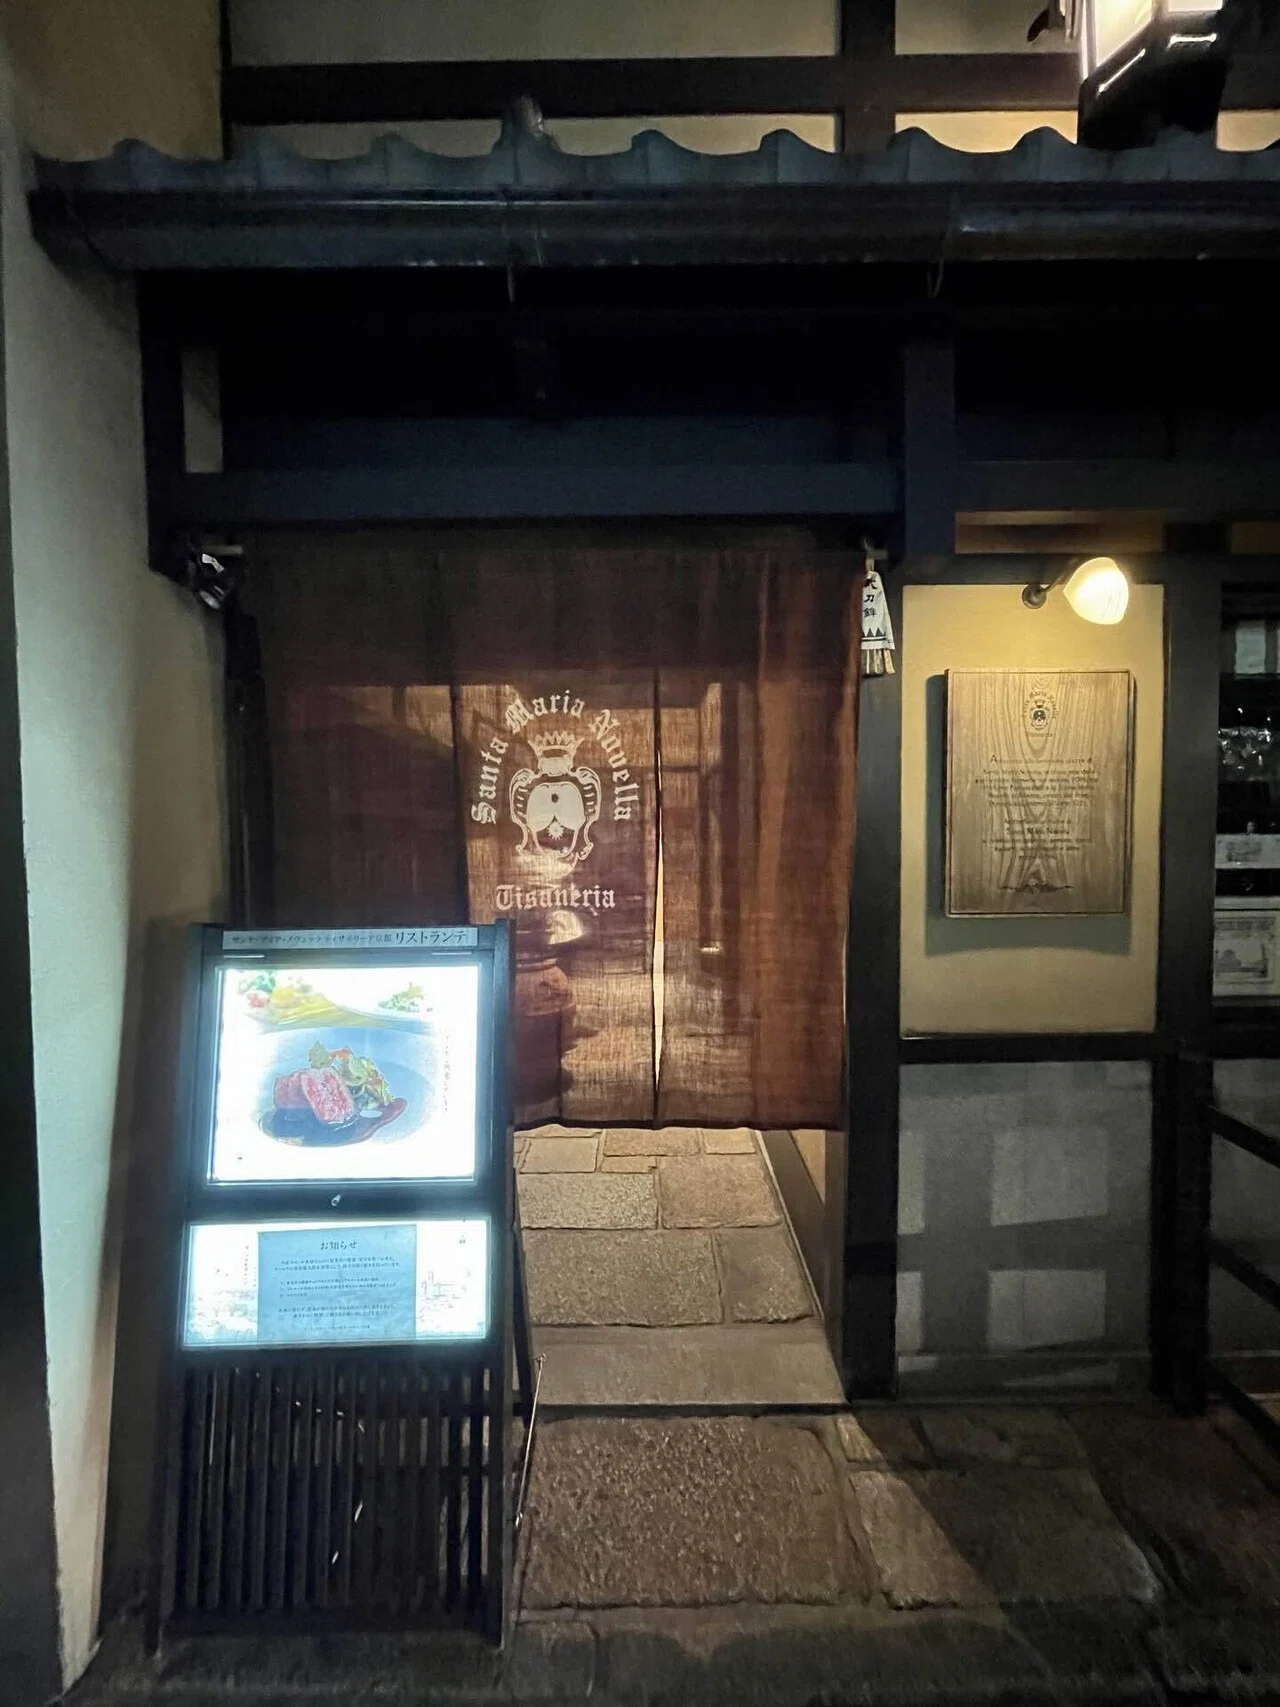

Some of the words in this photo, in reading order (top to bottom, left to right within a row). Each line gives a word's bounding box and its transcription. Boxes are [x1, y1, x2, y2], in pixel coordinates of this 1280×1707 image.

[471, 736, 509, 825] Santa
[505, 690, 585, 734] Maria
[588, 709, 640, 821] Novella
[495, 884, 616, 910] Tisaneria
[395, 930, 467, 944] リストランテ
[320, 1240, 358, 1251] お知らせ
